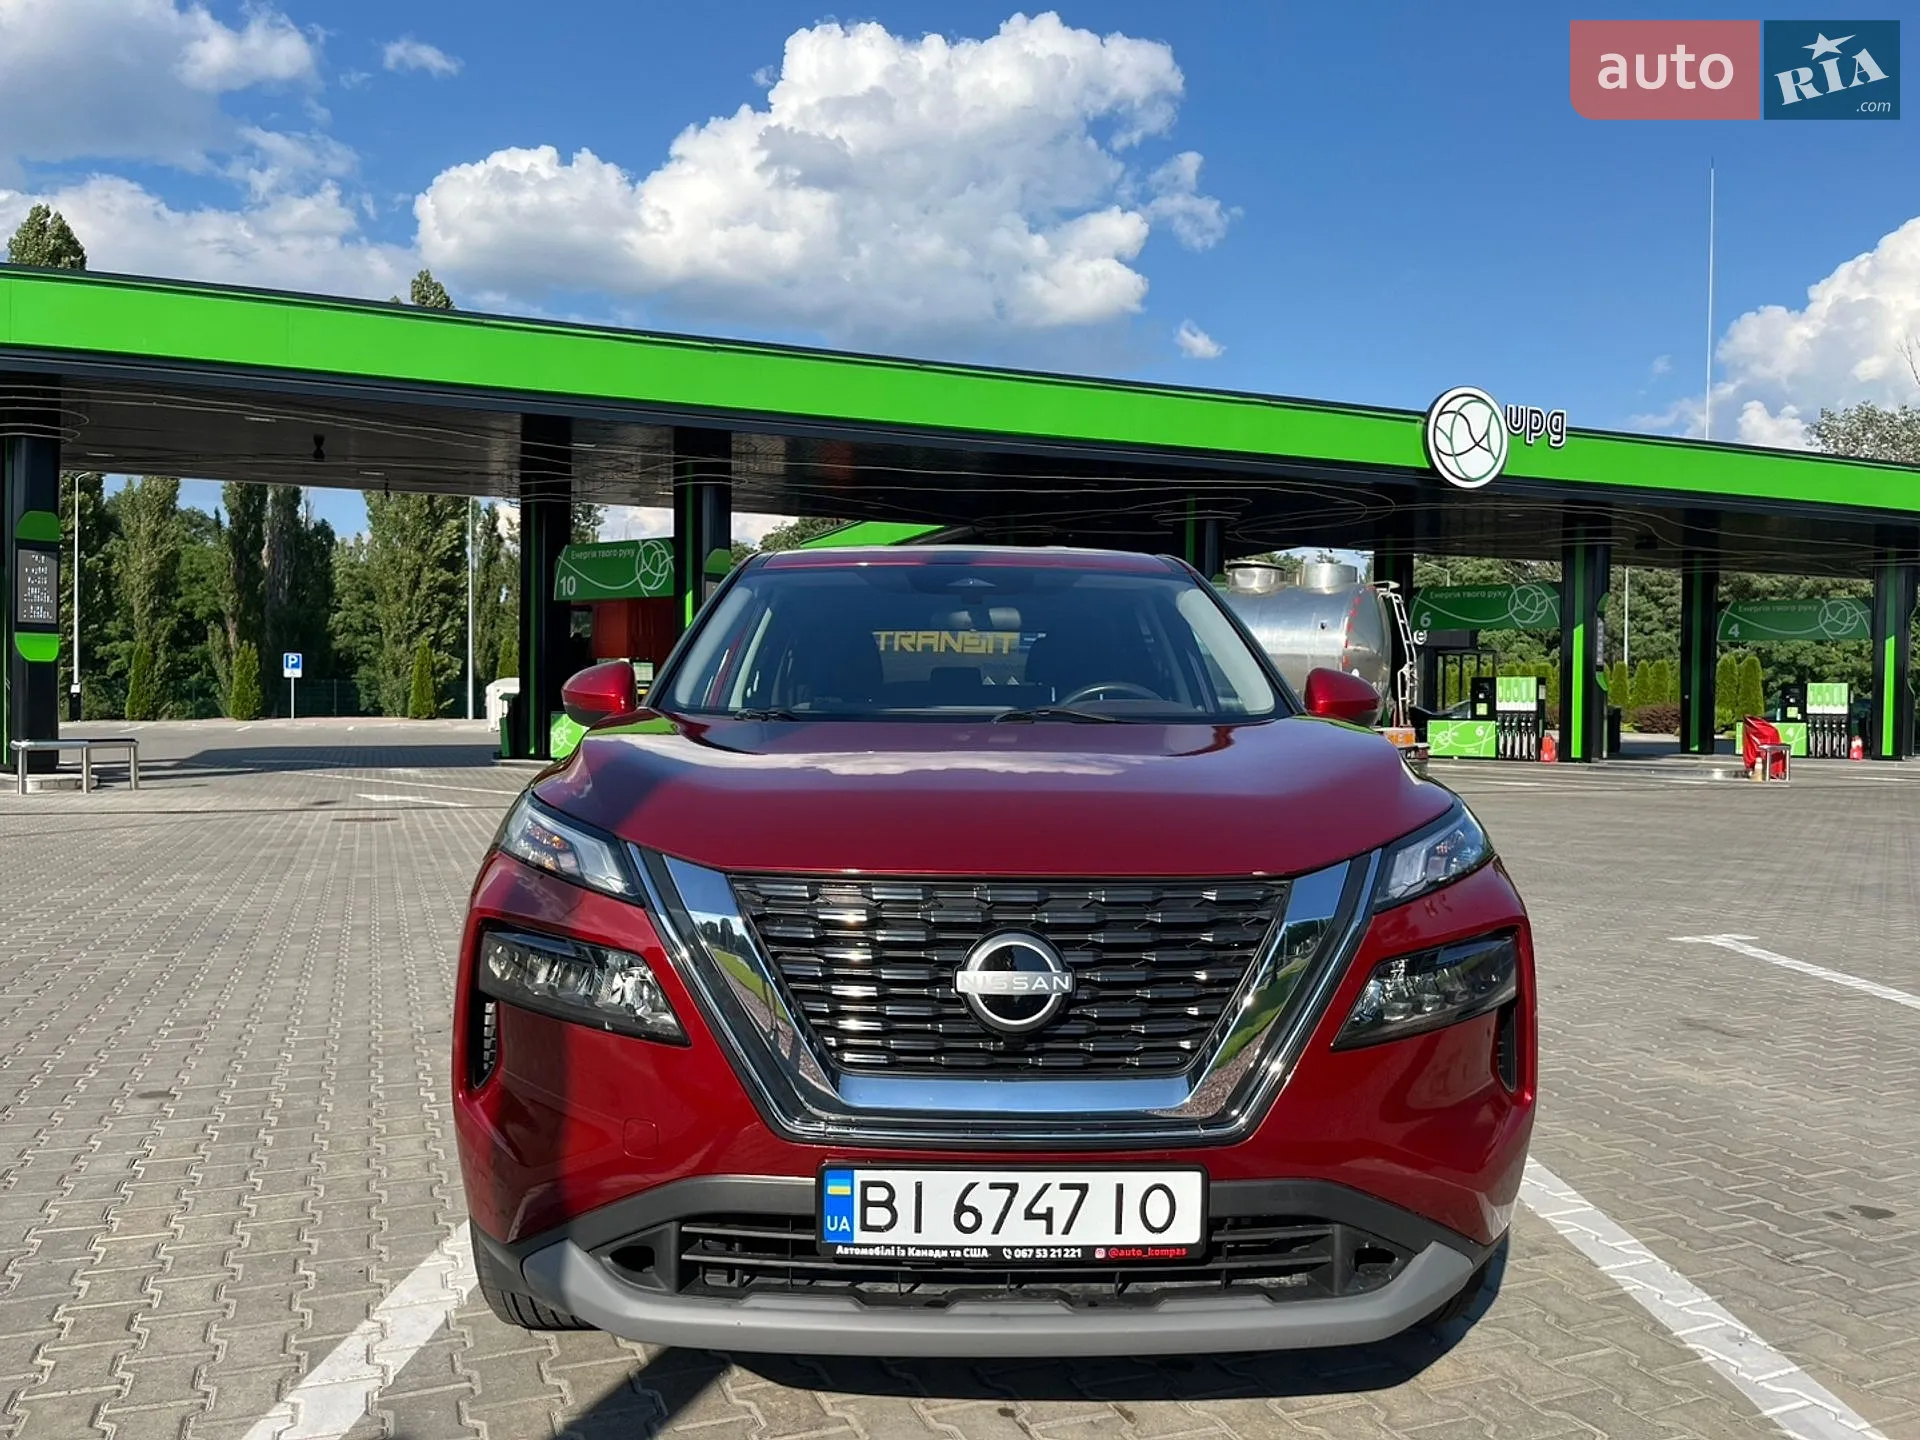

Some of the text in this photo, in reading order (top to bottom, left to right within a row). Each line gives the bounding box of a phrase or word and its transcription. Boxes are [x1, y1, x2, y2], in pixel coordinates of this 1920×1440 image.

[1506, 404, 1567, 447] upg
[560, 576, 576, 596] 10
[1420, 612, 1432, 628] 6
[1728, 623, 1740, 638] 4
[872, 631, 1019, 654] TRANSIT
[288, 655, 298, 668] P
[960, 975, 1069, 991] NISSAN
[859, 1180, 1177, 1236] BI 6747 IO
[827, 1215, 850, 1232] UA
[836, 1245, 989, 1258] Автомобілі із Канади та США
[1014, 1247, 1082, 1258] 067 53 21 221
[1108, 1247, 1187, 1258] @auto_kompas
